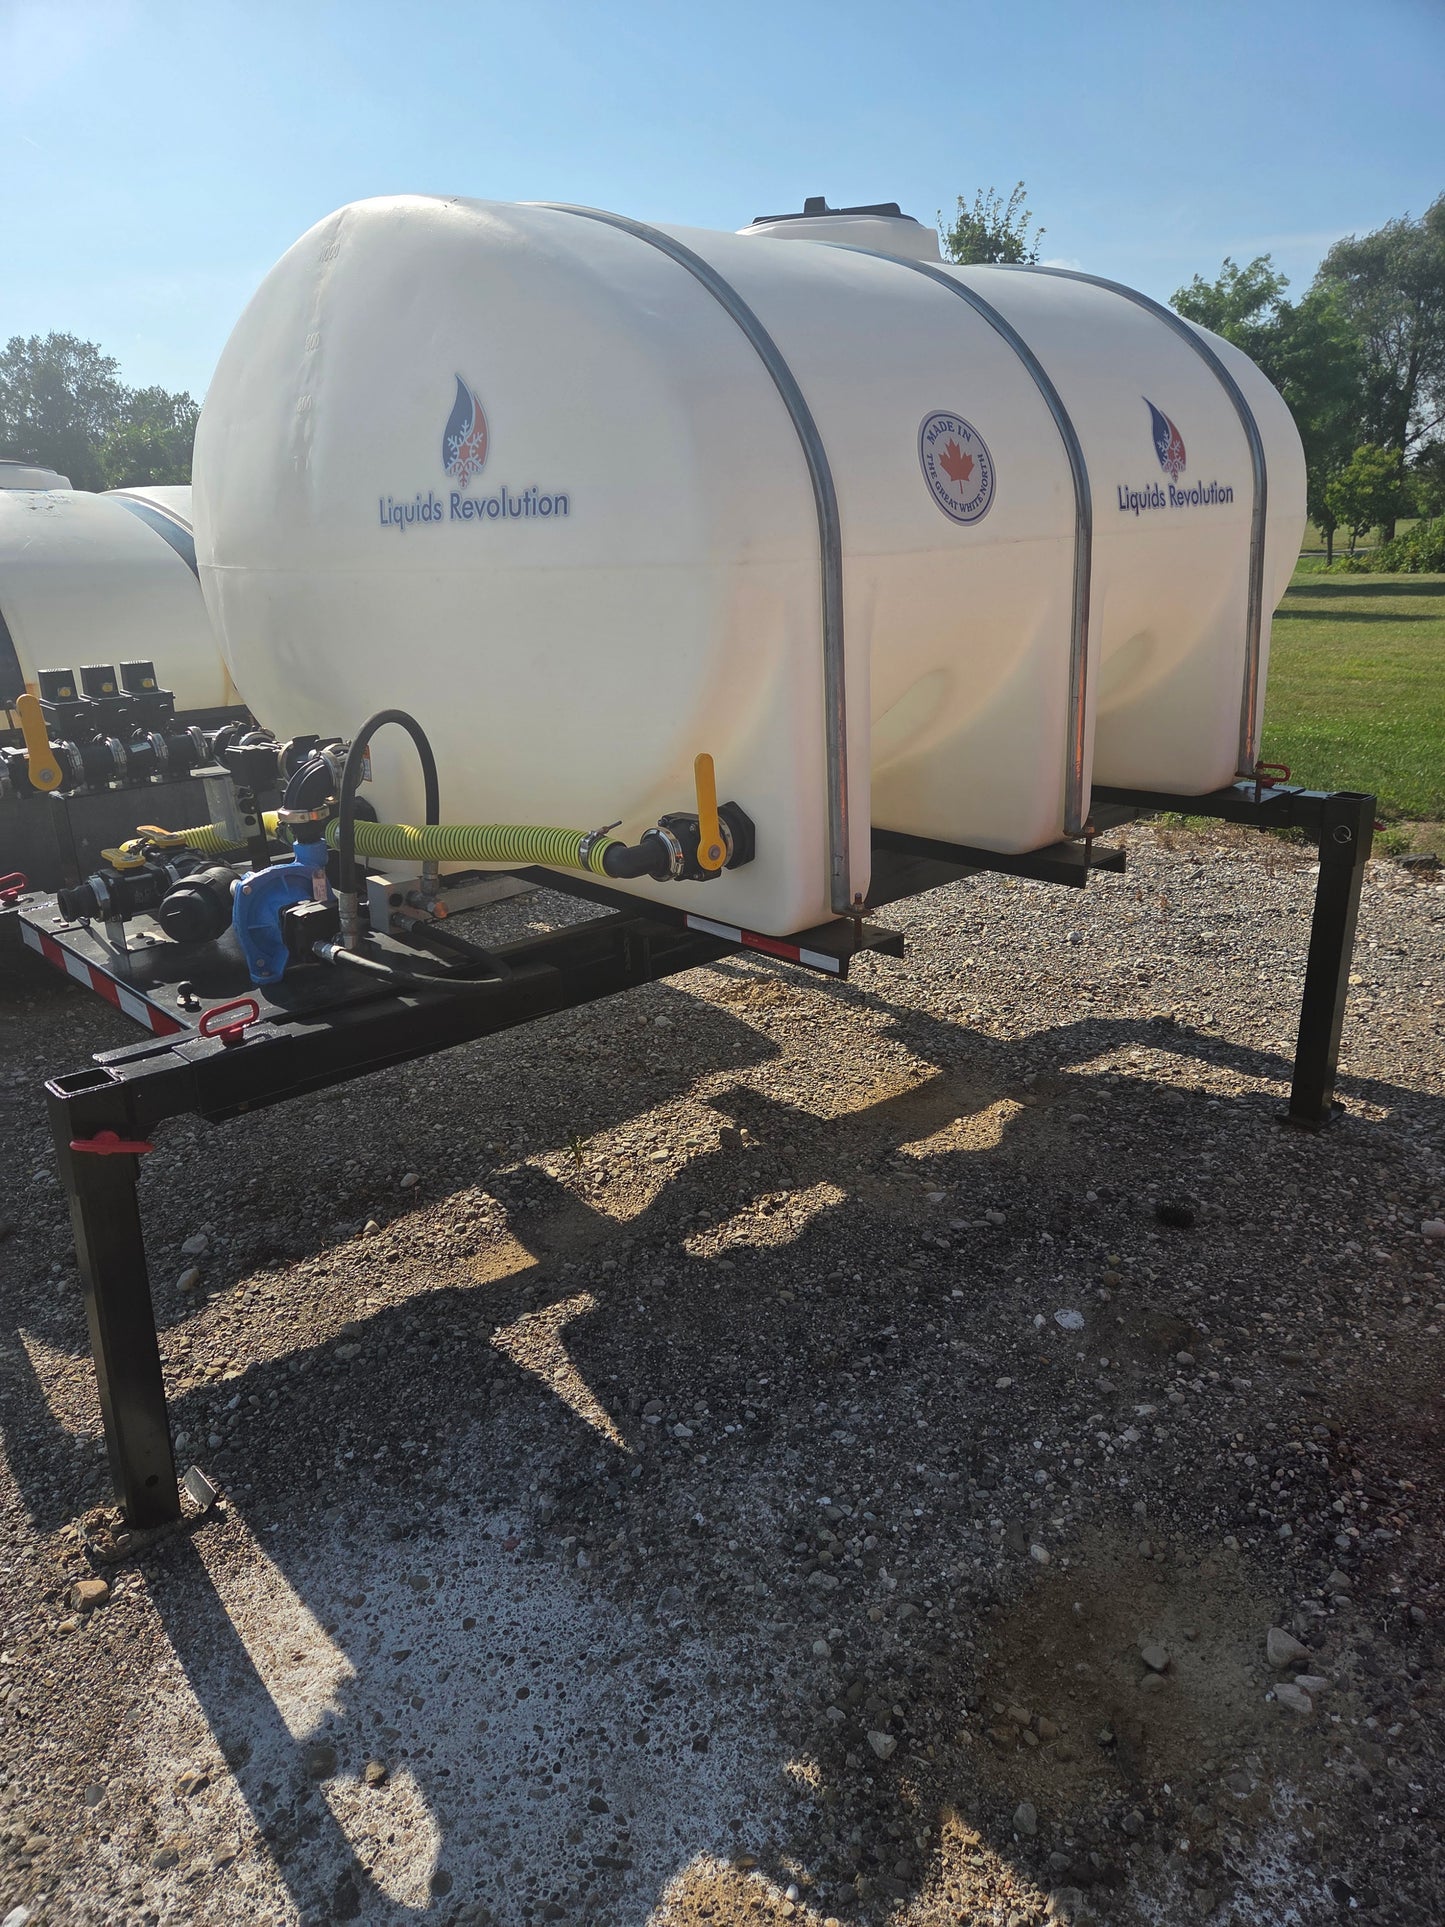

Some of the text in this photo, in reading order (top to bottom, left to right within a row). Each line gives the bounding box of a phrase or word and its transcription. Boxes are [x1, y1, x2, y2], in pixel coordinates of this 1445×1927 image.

[304, 331, 321, 352] 900
[926, 421, 972, 445] MADE IN
[926, 453, 989, 513] THE GREAT WHITE NORTH
[1117, 480, 1234, 516] Liquids Revolution
[379, 487, 569, 531] Liquids Revolution
